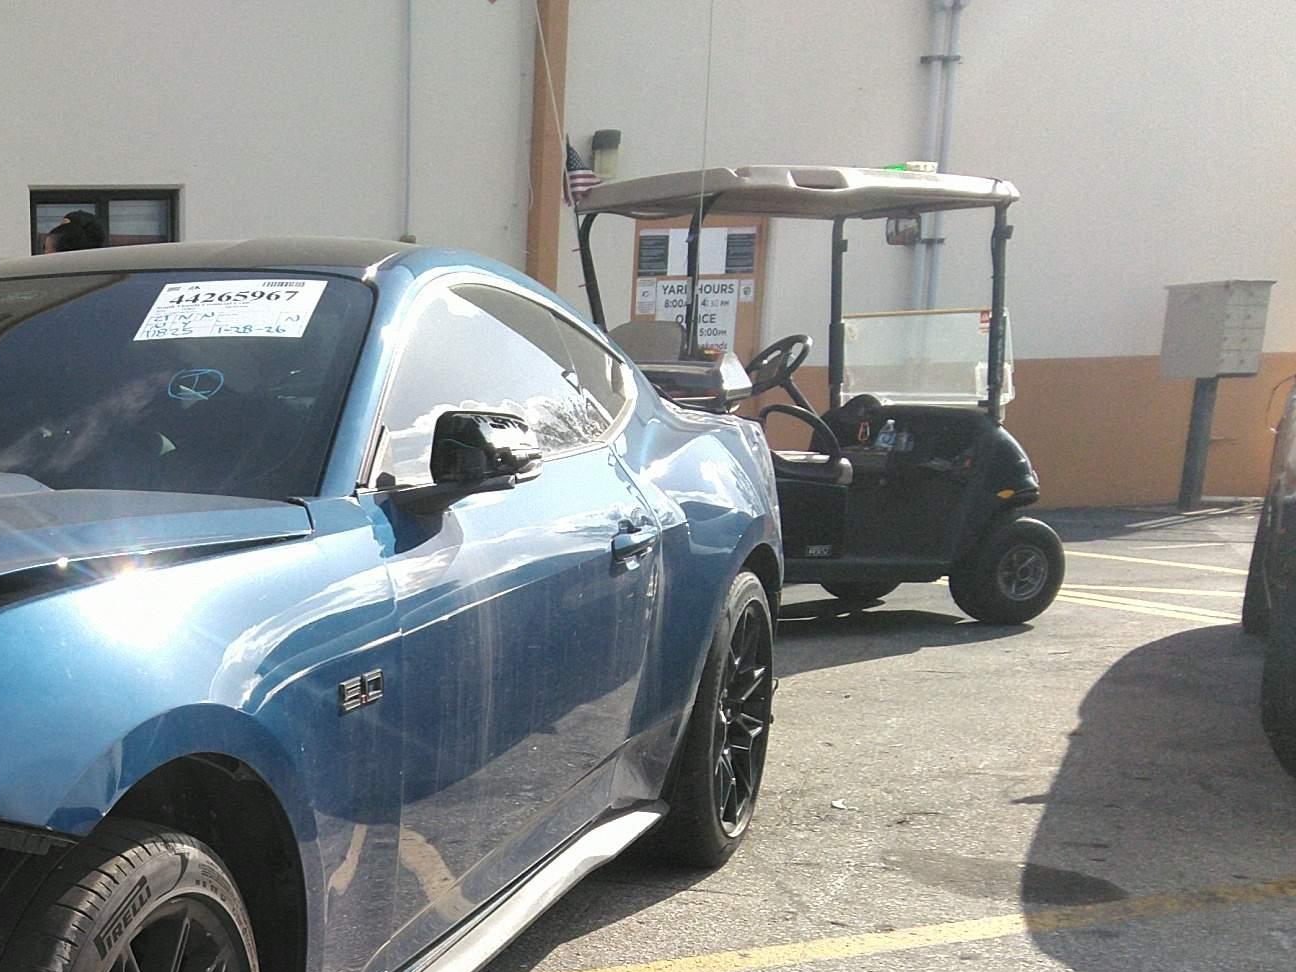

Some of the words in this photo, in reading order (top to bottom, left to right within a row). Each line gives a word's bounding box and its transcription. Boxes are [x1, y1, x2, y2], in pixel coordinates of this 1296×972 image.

[169, 290, 299, 304] 44265967
[339, 668, 384, 711] 5.0
[93, 875, 153, 961] PIRELLI
